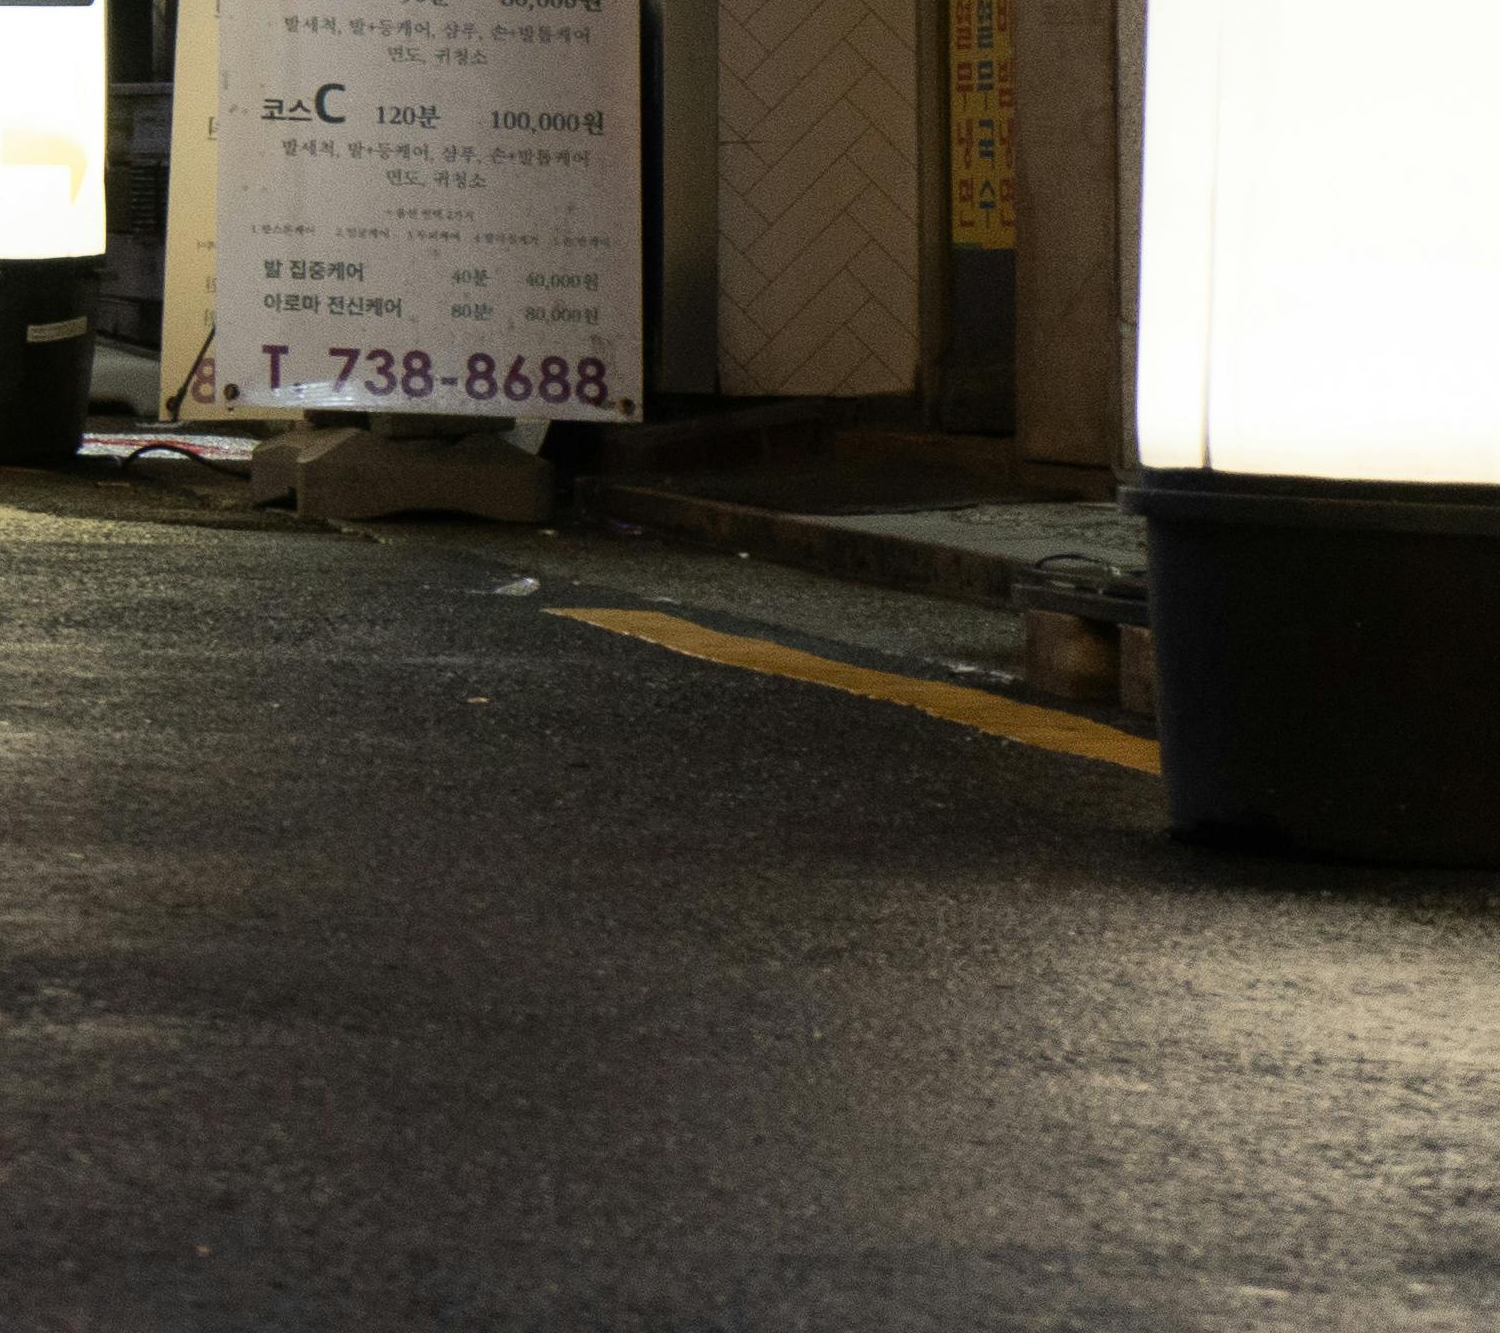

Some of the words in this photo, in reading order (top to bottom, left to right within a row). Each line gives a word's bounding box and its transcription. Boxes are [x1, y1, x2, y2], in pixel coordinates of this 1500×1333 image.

[375, 103, 441, 130] 120분
[490, 109, 605, 136] 100,000원
[328, 347, 610, 407] 738-8688
